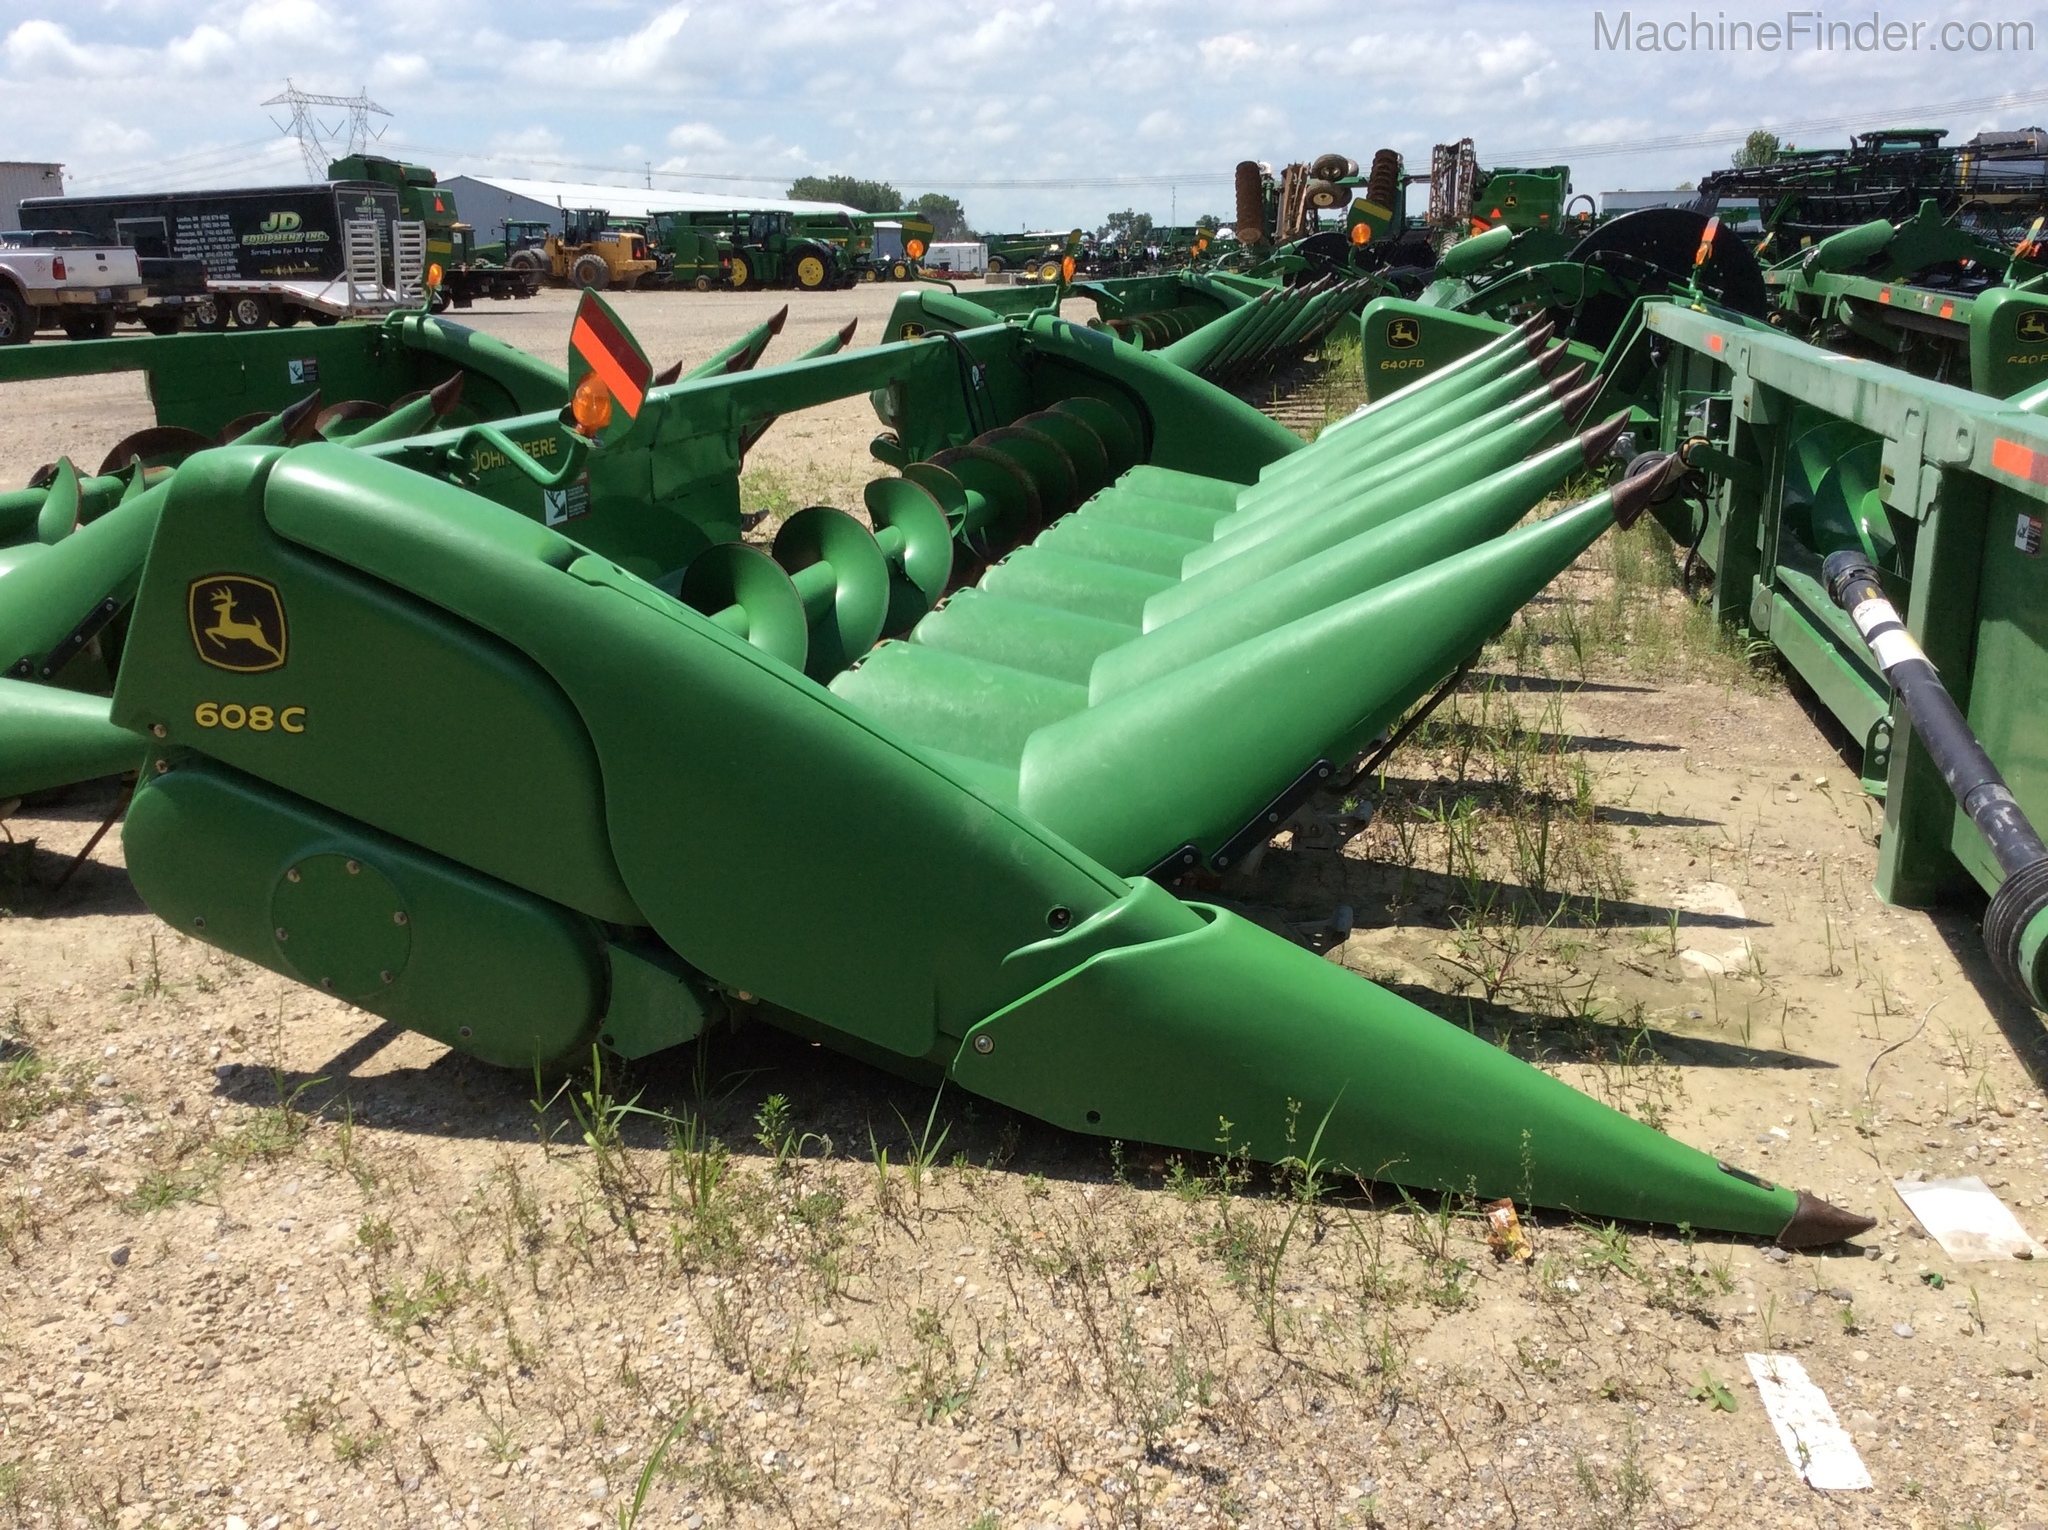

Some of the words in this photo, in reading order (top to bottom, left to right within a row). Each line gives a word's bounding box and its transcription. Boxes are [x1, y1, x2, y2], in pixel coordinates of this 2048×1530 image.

[260, 211, 302, 234] JD
[242, 232, 305, 245] EQUIPMENT
[305, 231, 330, 243] INC.
